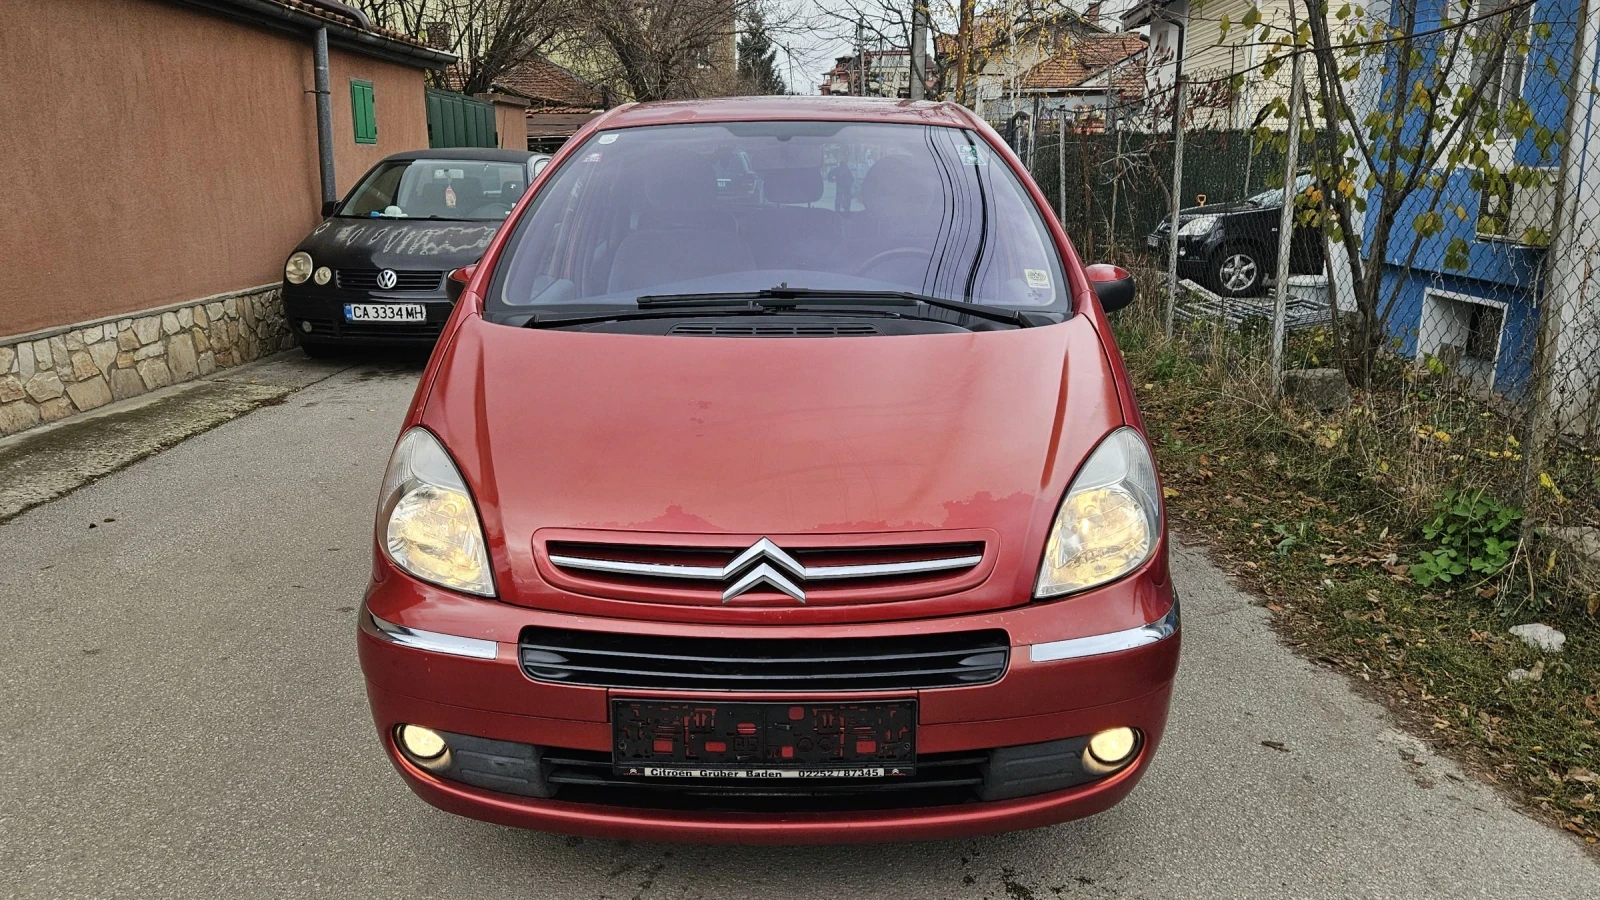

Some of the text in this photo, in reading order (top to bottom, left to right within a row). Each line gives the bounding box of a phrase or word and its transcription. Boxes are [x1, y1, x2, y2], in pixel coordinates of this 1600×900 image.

[353, 305, 424, 319] CA 3334 MH
[650, 768, 693, 777] Citroen
[700, 769, 739, 778] Gruber
[746, 769, 782, 778] Baden
